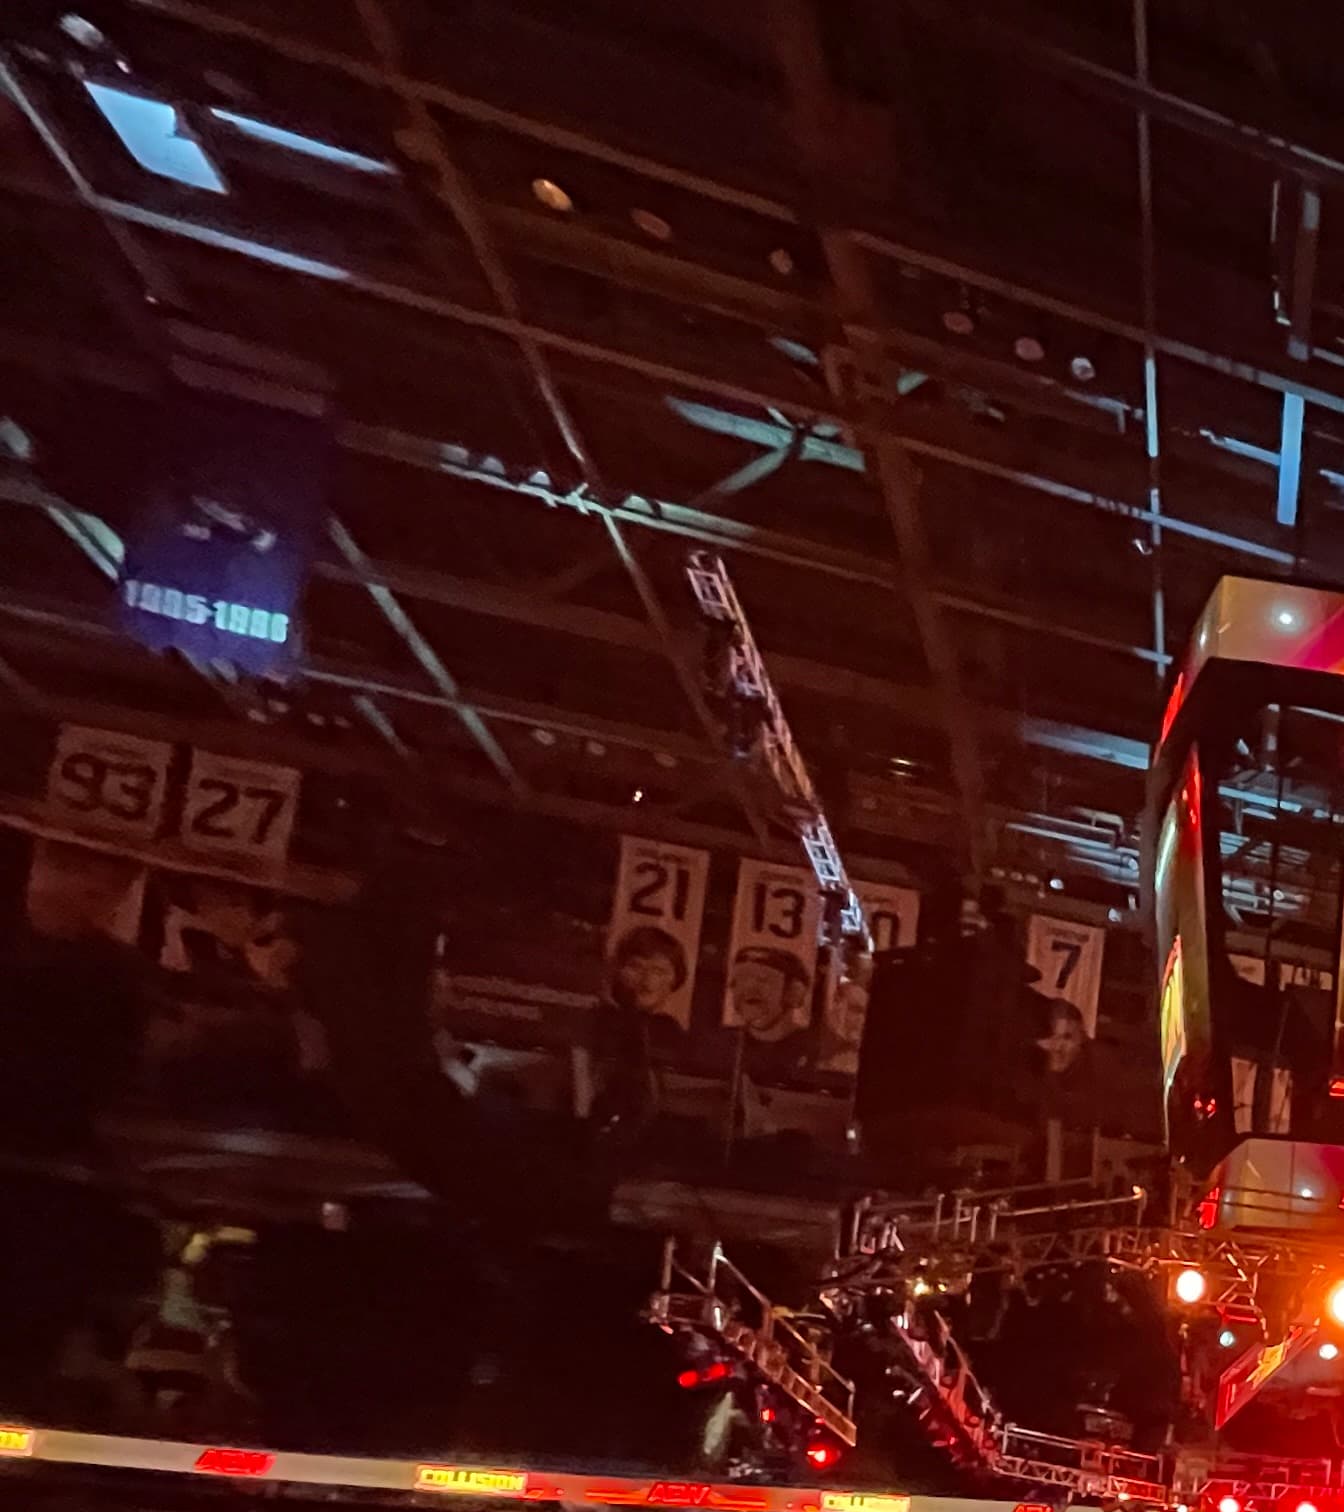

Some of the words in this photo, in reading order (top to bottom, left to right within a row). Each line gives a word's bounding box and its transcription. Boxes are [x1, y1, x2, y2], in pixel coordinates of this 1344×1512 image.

[191, 778, 285, 844] 27
[628, 861, 690, 921] 21
[754, 882, 804, 939] 13
[1051, 941, 1082, 989] 7
[420, 1469, 525, 1491] COLLISION
[648, 1484, 711, 1504] AEW
